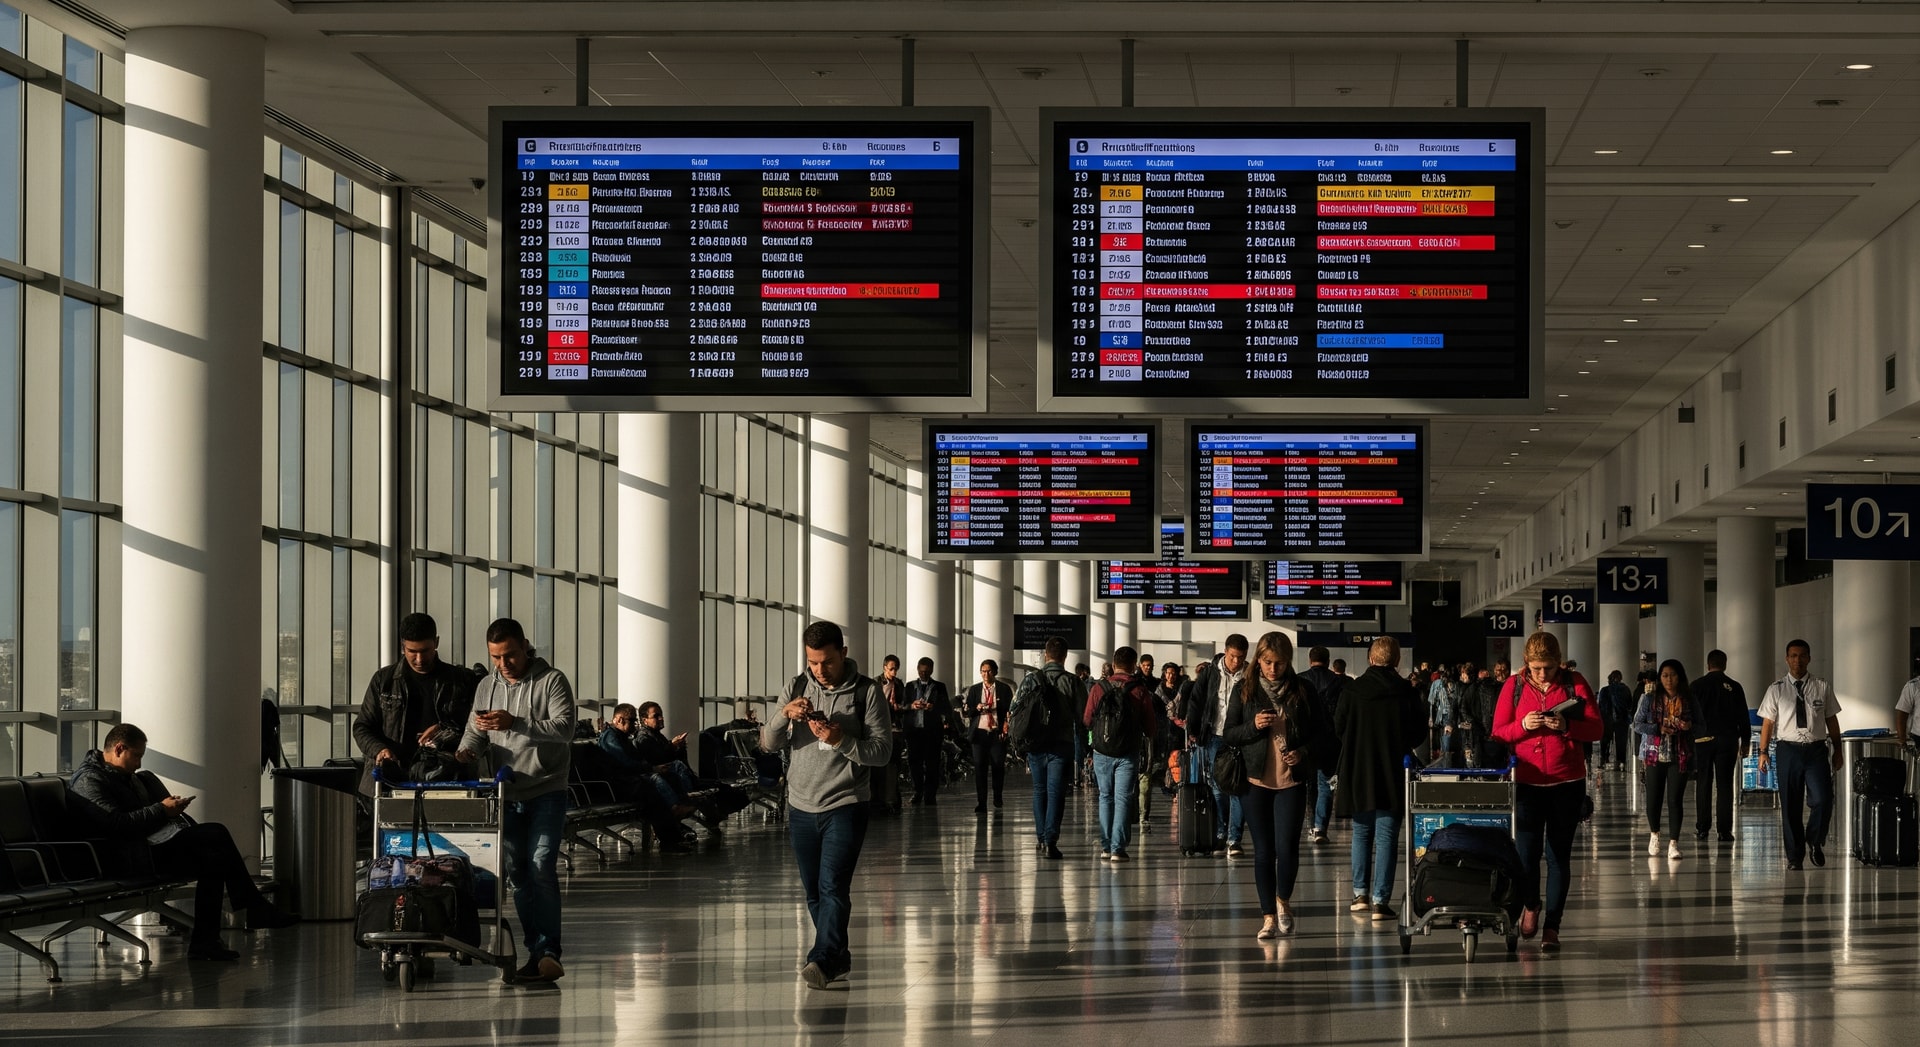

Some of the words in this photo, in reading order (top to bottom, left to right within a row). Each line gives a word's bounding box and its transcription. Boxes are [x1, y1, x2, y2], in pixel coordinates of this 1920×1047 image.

[1824, 496, 1881, 539] 10
[1606, 565, 1641, 593] 13
[1549, 594, 1574, 615] 16
